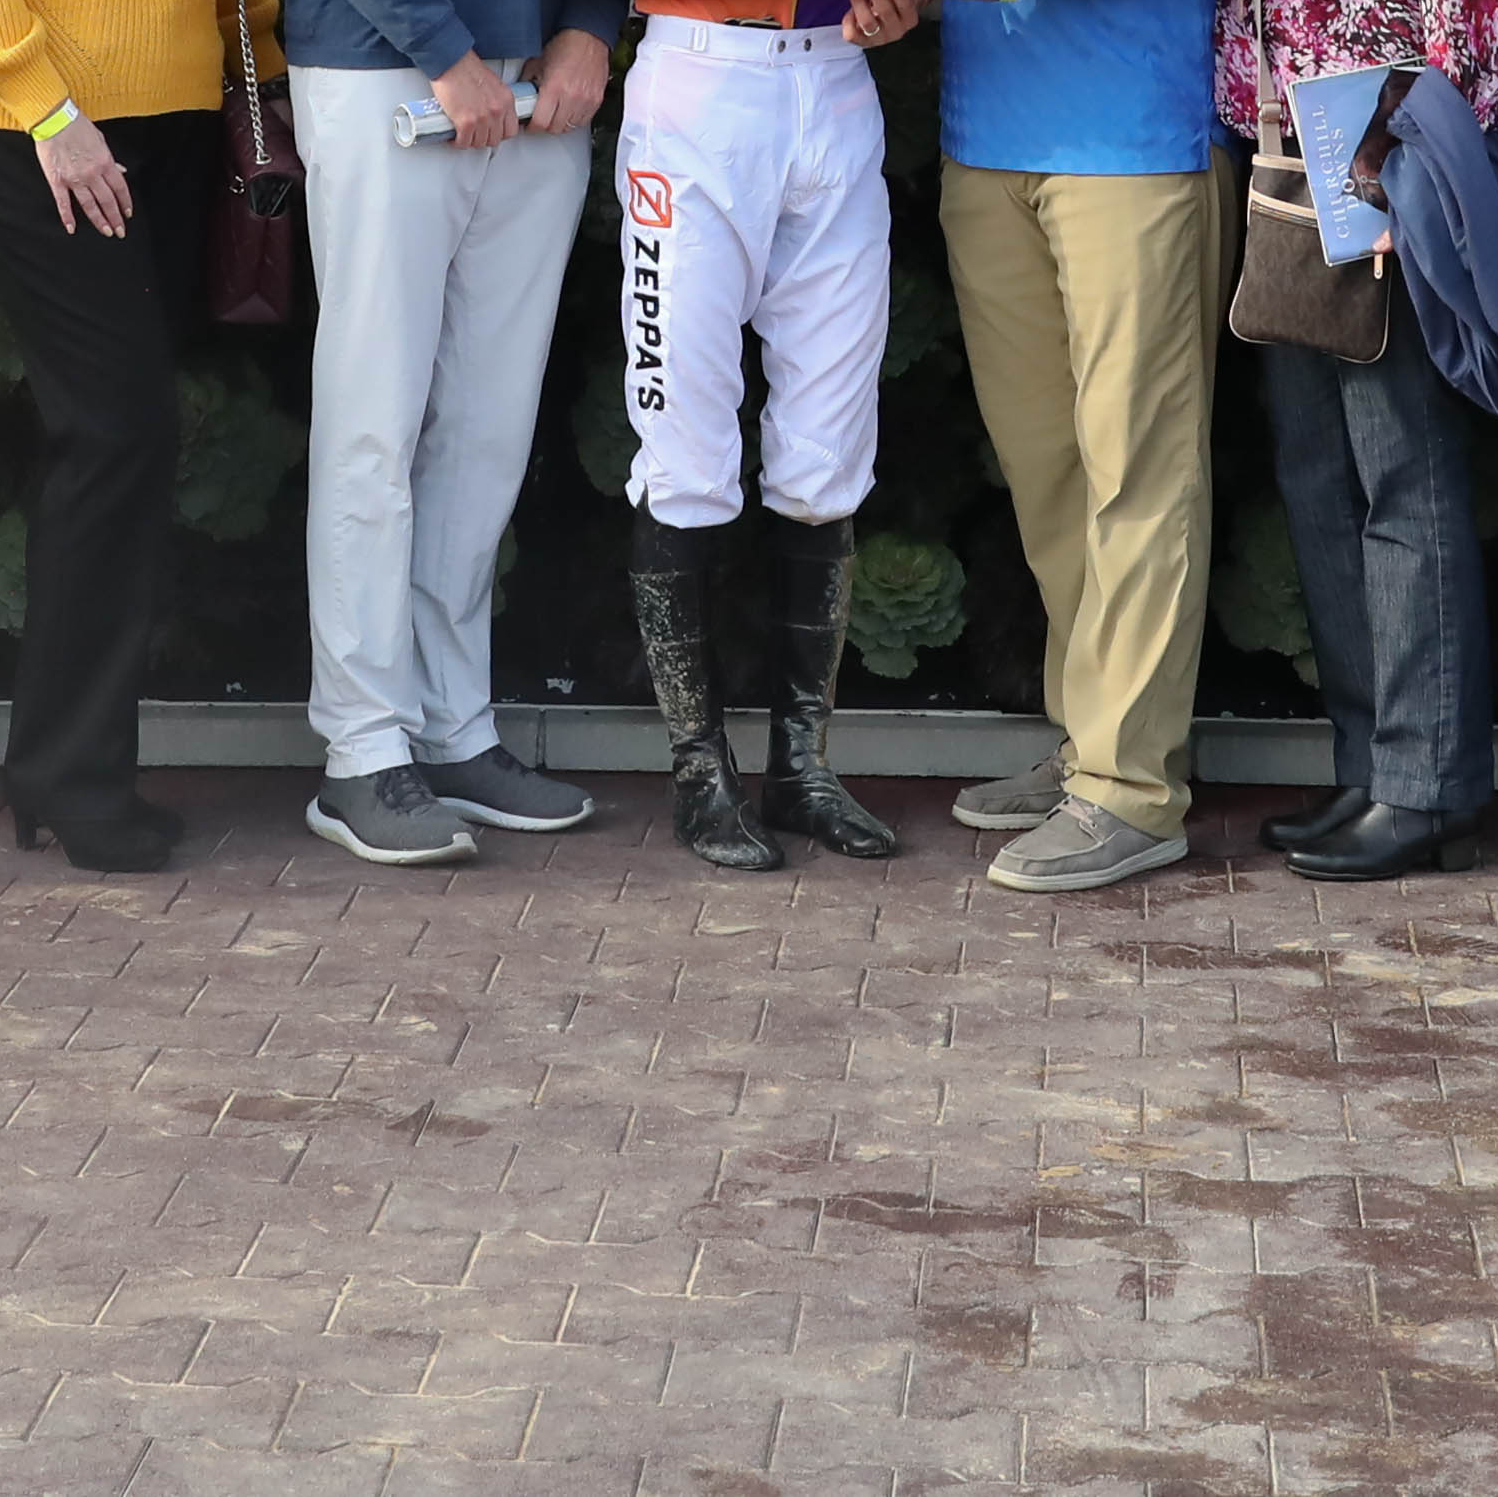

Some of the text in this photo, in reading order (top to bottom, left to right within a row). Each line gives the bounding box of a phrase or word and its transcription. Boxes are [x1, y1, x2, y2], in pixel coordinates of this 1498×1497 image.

[1312, 103, 1350, 239] CHURCHILL
[1332, 127, 1360, 212] DOWNS
[633, 234, 666, 413] ZEPPA'S
